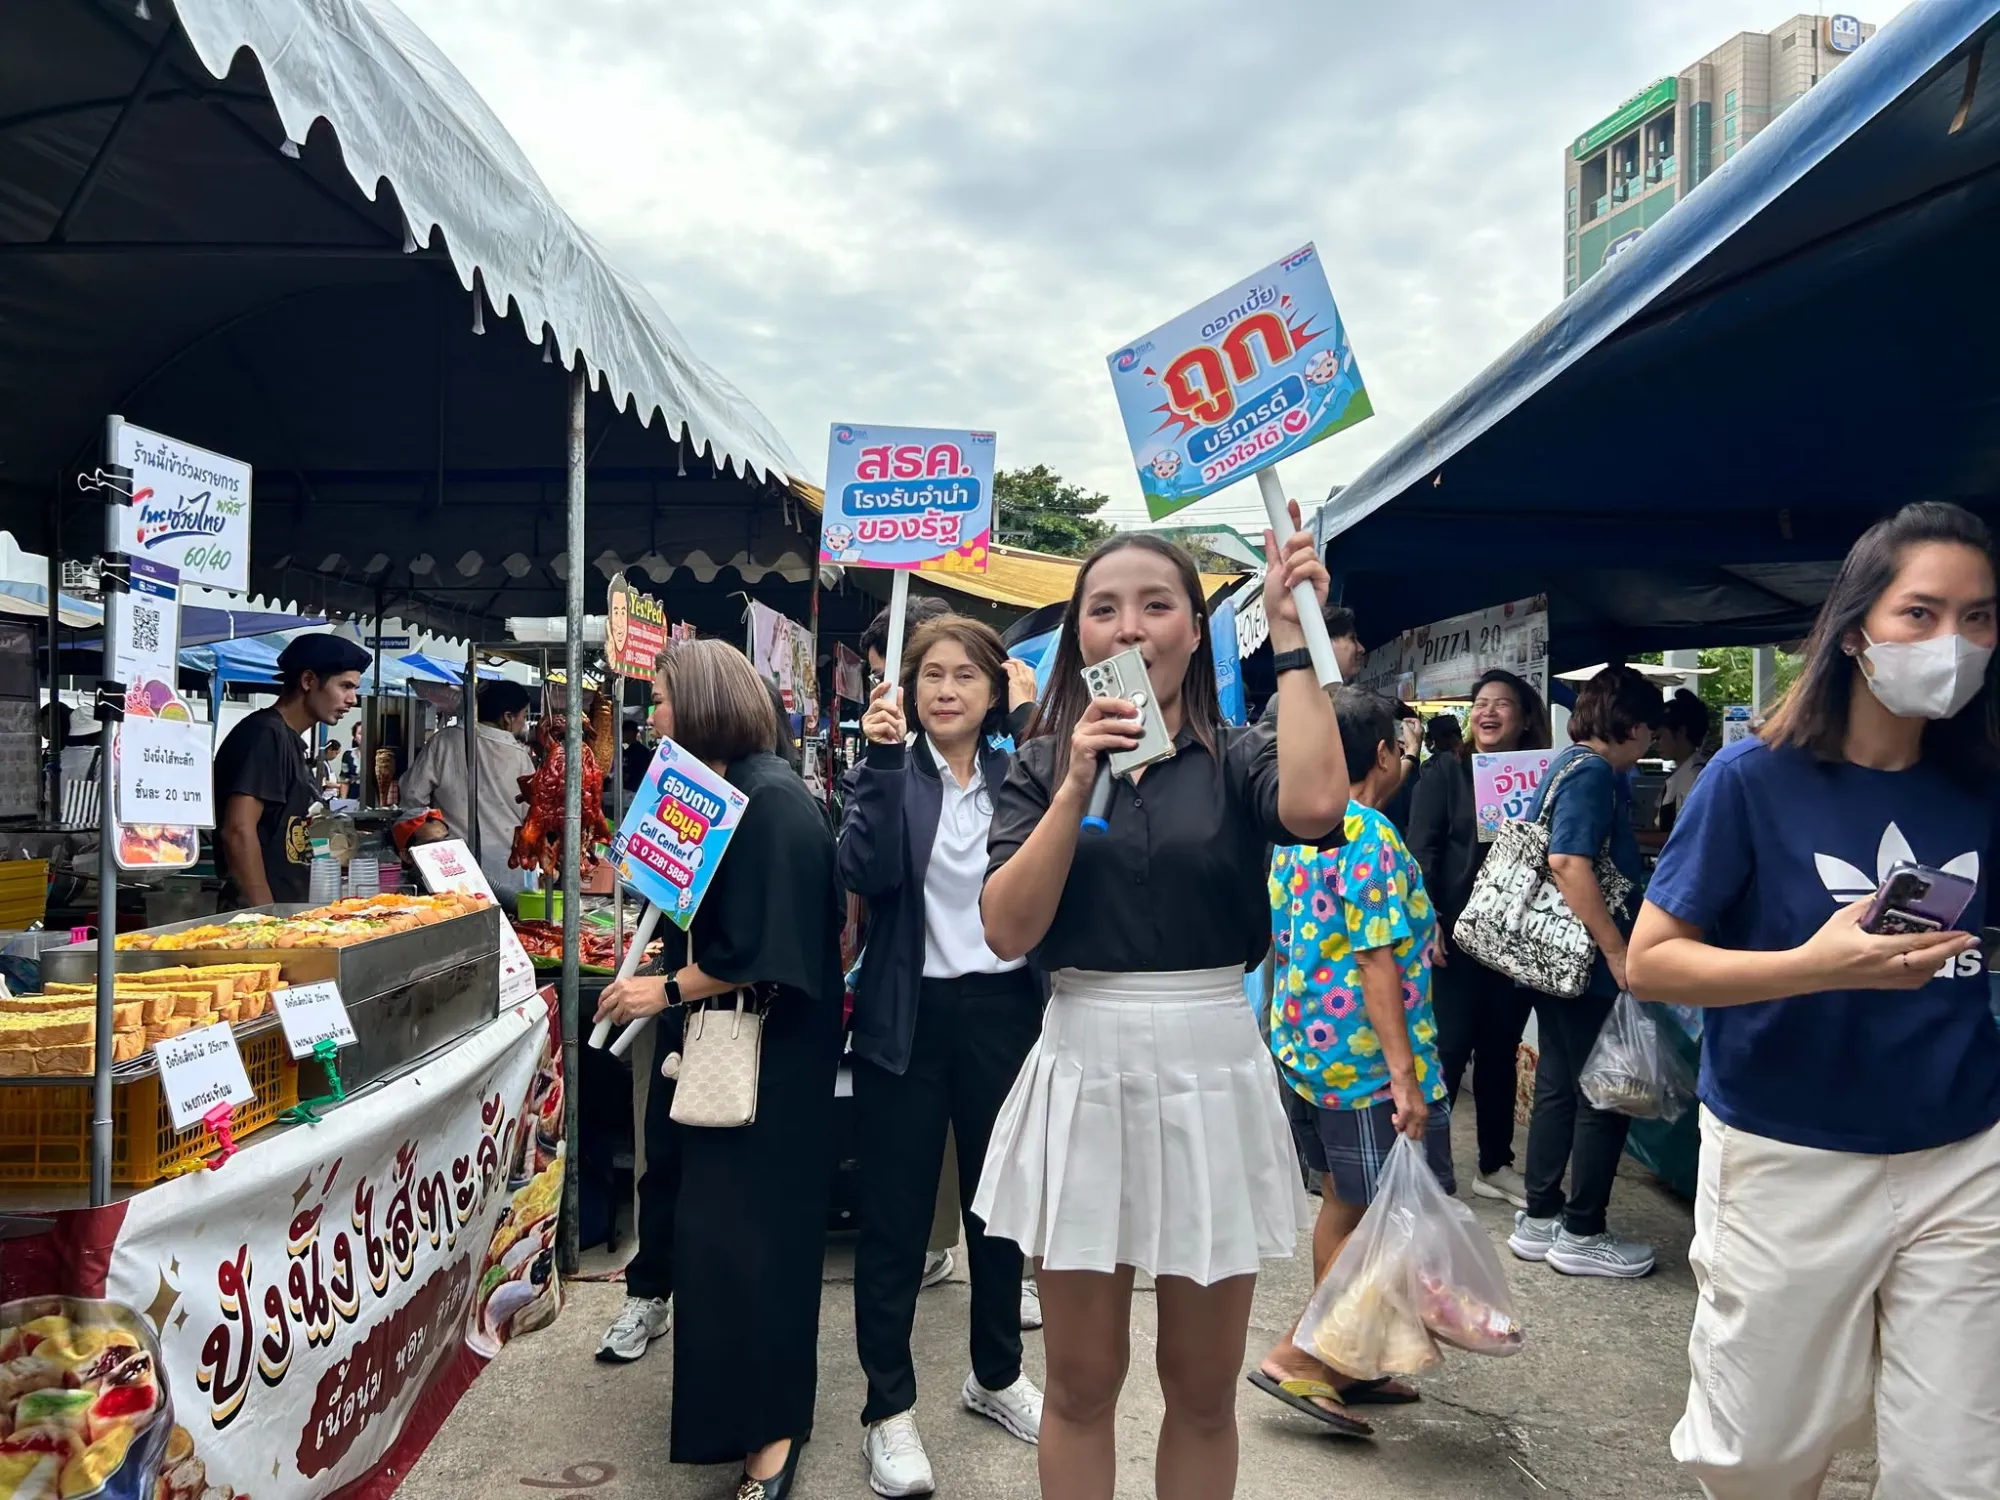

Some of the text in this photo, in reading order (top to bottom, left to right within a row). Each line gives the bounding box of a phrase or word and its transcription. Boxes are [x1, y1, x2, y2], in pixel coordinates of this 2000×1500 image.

[1201, 286, 1274, 338] ดอกเบี้ย
[1162, 312, 1291, 425] ถูก
[1204, 389, 1288, 452] บริการดี
[134, 441, 239, 493] ร้านนี้เข้าร่วมรายการ
[857, 443, 970, 480] สธค.
[1203, 425, 1279, 481] วางใจได้
[133, 488, 226, 543] ไทยช่วยไทย
[216, 495, 246, 516] พลัส
[853, 483, 968, 509] โรงรับจำนำ
[858, 510, 962, 543] ของรัฐ
[184, 543, 231, 573] 60/40
[1423, 624, 1501, 665] PIZZA 20
[144, 746, 194, 767] ปังนึ่งไส้ทะลัก
[135, 778, 201, 802] ชิ้นละ 20 บาท
[663, 775, 720, 818] สอบถาม
[640, 821, 687, 860] Call Center
[662, 800, 703, 841] ข้อมูล
[641, 848, 690, 885] 0 2281 5888
[182, 1082, 233, 1113] เนยกระเทียม
[198, 1092, 516, 1427] ปังนึ่งไส้ทะลัก
[315, 1357, 382, 1450] เนื้อนุ่ม
[396, 1327, 427, 1373] หอม
